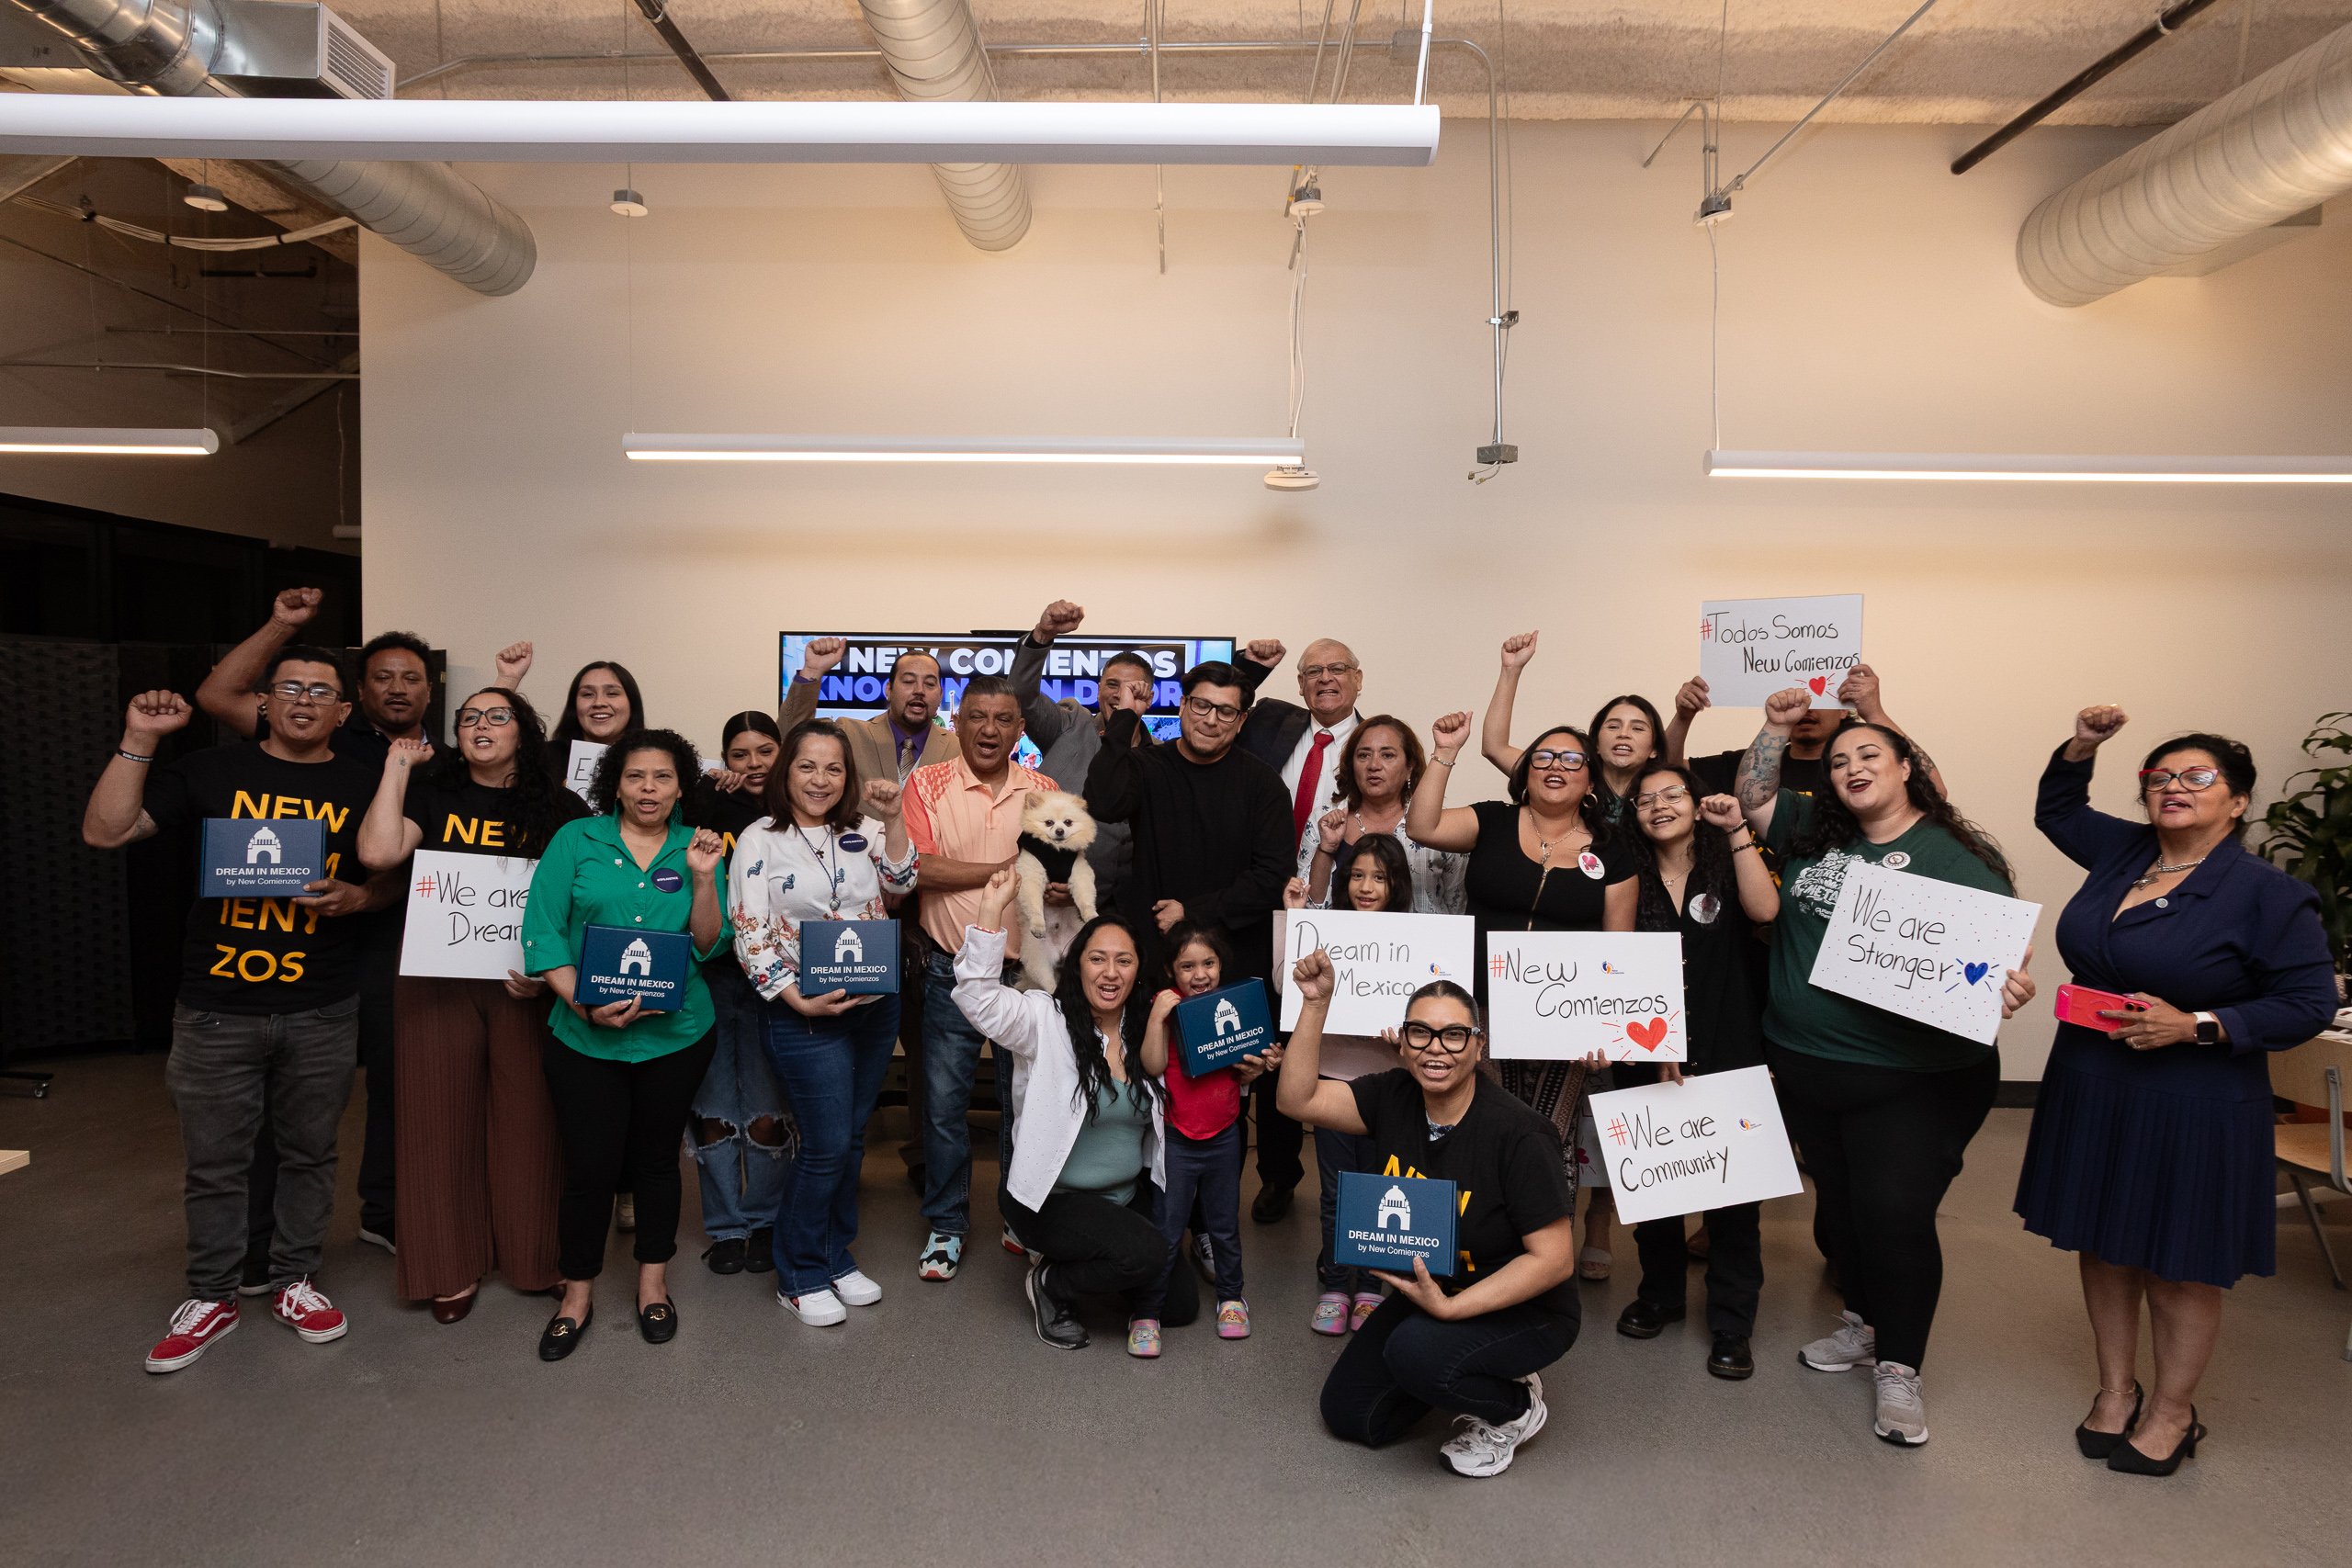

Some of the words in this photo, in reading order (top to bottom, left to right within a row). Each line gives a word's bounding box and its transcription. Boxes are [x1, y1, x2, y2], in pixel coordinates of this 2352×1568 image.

[1700, 611, 1769, 644] #Todos
[1772, 615, 1839, 639] Somos
[1743, 646, 1781, 674] New
[1784, 649, 1861, 673] Comienzos
[216, 867, 254, 875] DREAM
[256, 867, 267, 875] IN
[269, 867, 311, 875] MEXICO
[226, 878, 236, 886] by
[415, 870, 476, 907] #We
[1852, 885, 1891, 931] We
[1898, 918, 1945, 944] are
[209, 943, 307, 983] ZOS
[1389, 942, 1410, 963] in
[1488, 947, 1577, 984] #New
[1848, 933, 1954, 990] Stronger
[591, 975, 625, 986] DREAM
[627, 977, 637, 987] IN
[639, 979, 674, 989] MEXICO
[1334, 967, 1416, 997] Mexico
[1535, 982, 1668, 1019] Comienzos
[1197, 1039, 1226, 1054] DREAM
[1226, 1036, 1235, 1045] IN
[1235, 1026, 1264, 1043] MEXICO
[1215, 1049, 1228, 1057] New
[1228, 1039, 1260, 1053] Comienzos
[1607, 1105, 1674, 1150] #We
[1680, 1116, 1716, 1139] are
[1620, 1145, 1728, 1192] Community
[1348, 1230, 1385, 1242] DREAM
[1386, 1234, 1397, 1243] IN
[1399, 1235, 1440, 1247] MEXICO
[1358, 1243, 1367, 1252] by
[1368, 1245, 1386, 1253] New
[1387, 1247, 1430, 1258] Comienzos
